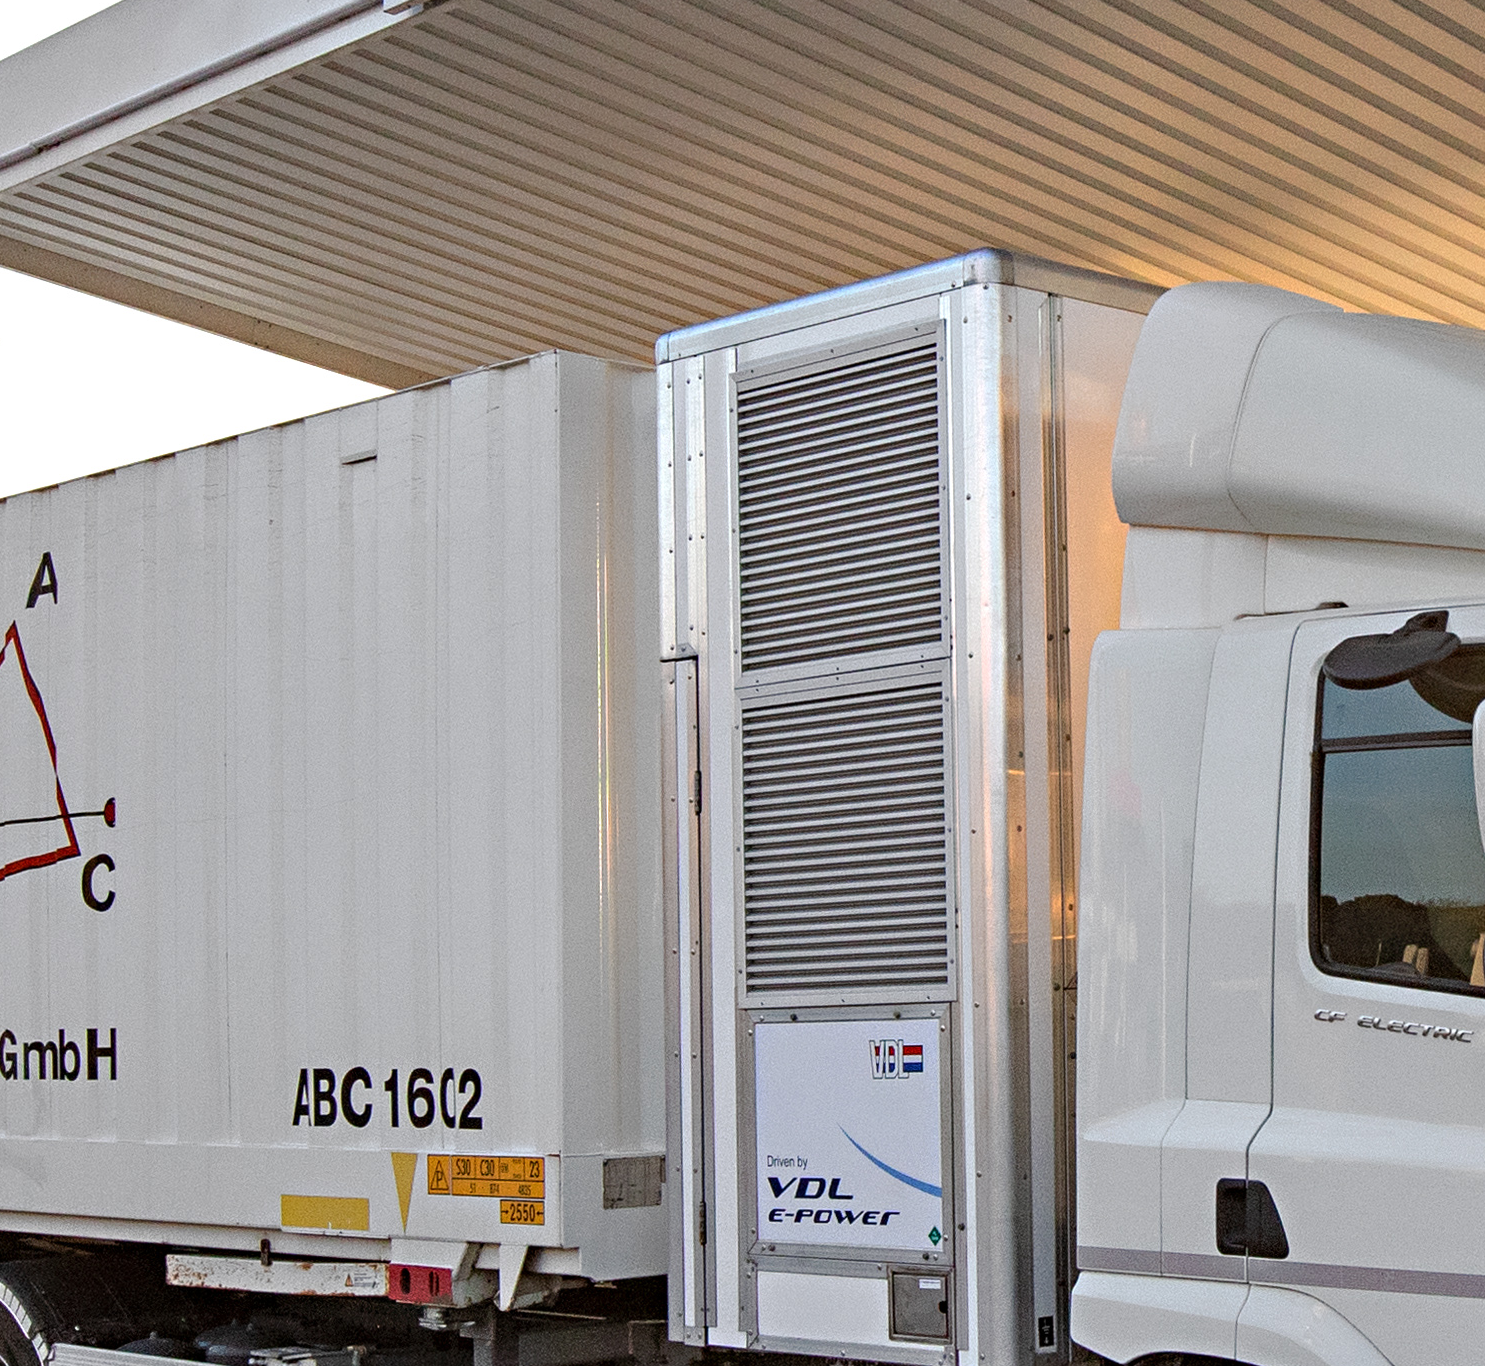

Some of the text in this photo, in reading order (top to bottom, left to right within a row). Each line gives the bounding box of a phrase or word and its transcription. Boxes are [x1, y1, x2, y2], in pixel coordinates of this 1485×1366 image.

[25, 551, 59, 609] A
[81, 853, 116, 912] C
[1314, 1008, 1475, 1043] CF ELECTRIC
[868, 1038, 910, 1080] VDL
[292, 1066, 483, 1130] ABC 1602
[529, 1160, 540, 1179] 23
[766, 1155, 808, 1170] Driven by
[767, 1176, 855, 1200] VDL
[509, 1203, 536, 1222] 2550
